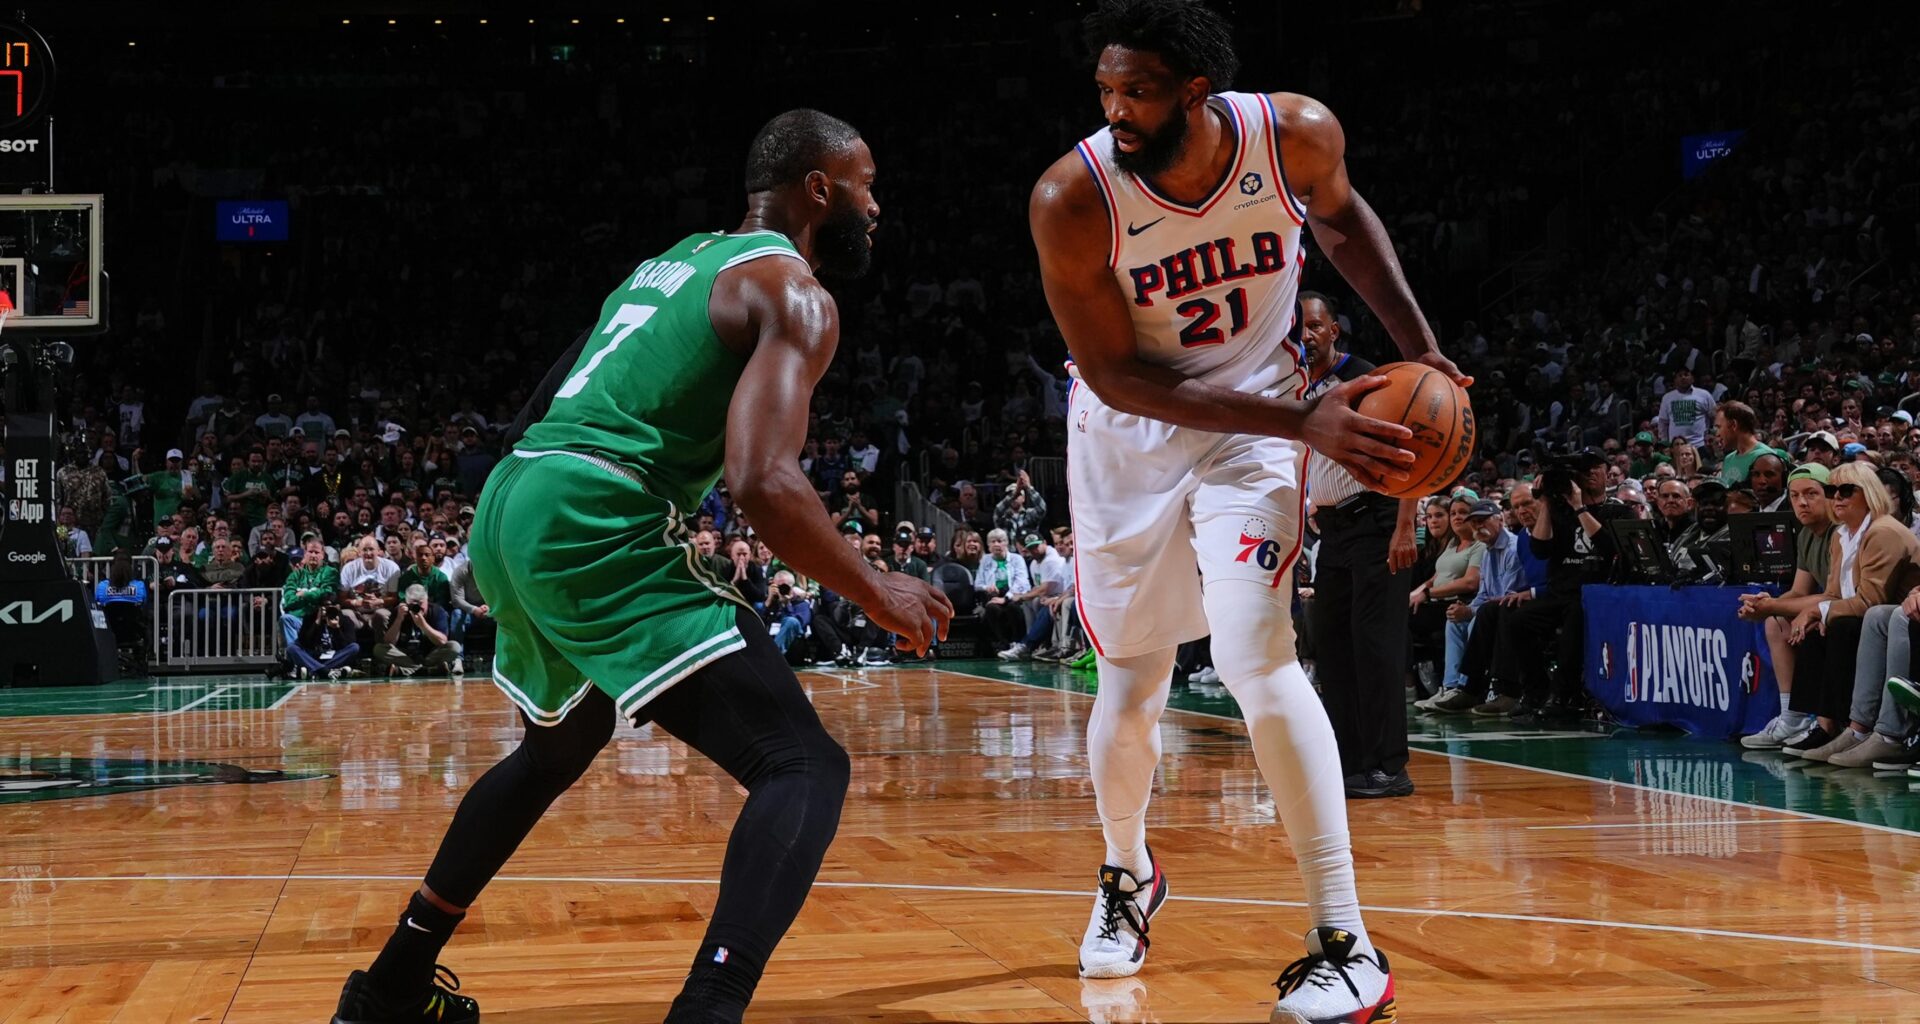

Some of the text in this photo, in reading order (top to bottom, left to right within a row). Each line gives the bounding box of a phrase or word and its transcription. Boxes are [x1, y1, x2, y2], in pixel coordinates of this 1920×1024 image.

[6, 42, 29, 67] 17
[0, 139, 39, 152] SOT
[1233, 193, 1277, 211] crypto.com
[232, 214, 272, 224] ULTRA
[628, 259, 697, 298] BROWN
[1129, 231, 1286, 308] PHILA
[1176, 287, 1249, 349] 21
[554, 303, 659, 398] 7
[15, 459, 38, 478] GET
[15, 479, 38, 498] THE
[20, 499, 44, 524] App
[8, 551, 47, 564] Google
[1234, 532, 1281, 571] 76
[1641, 623, 1730, 712] PLAYOFFS
